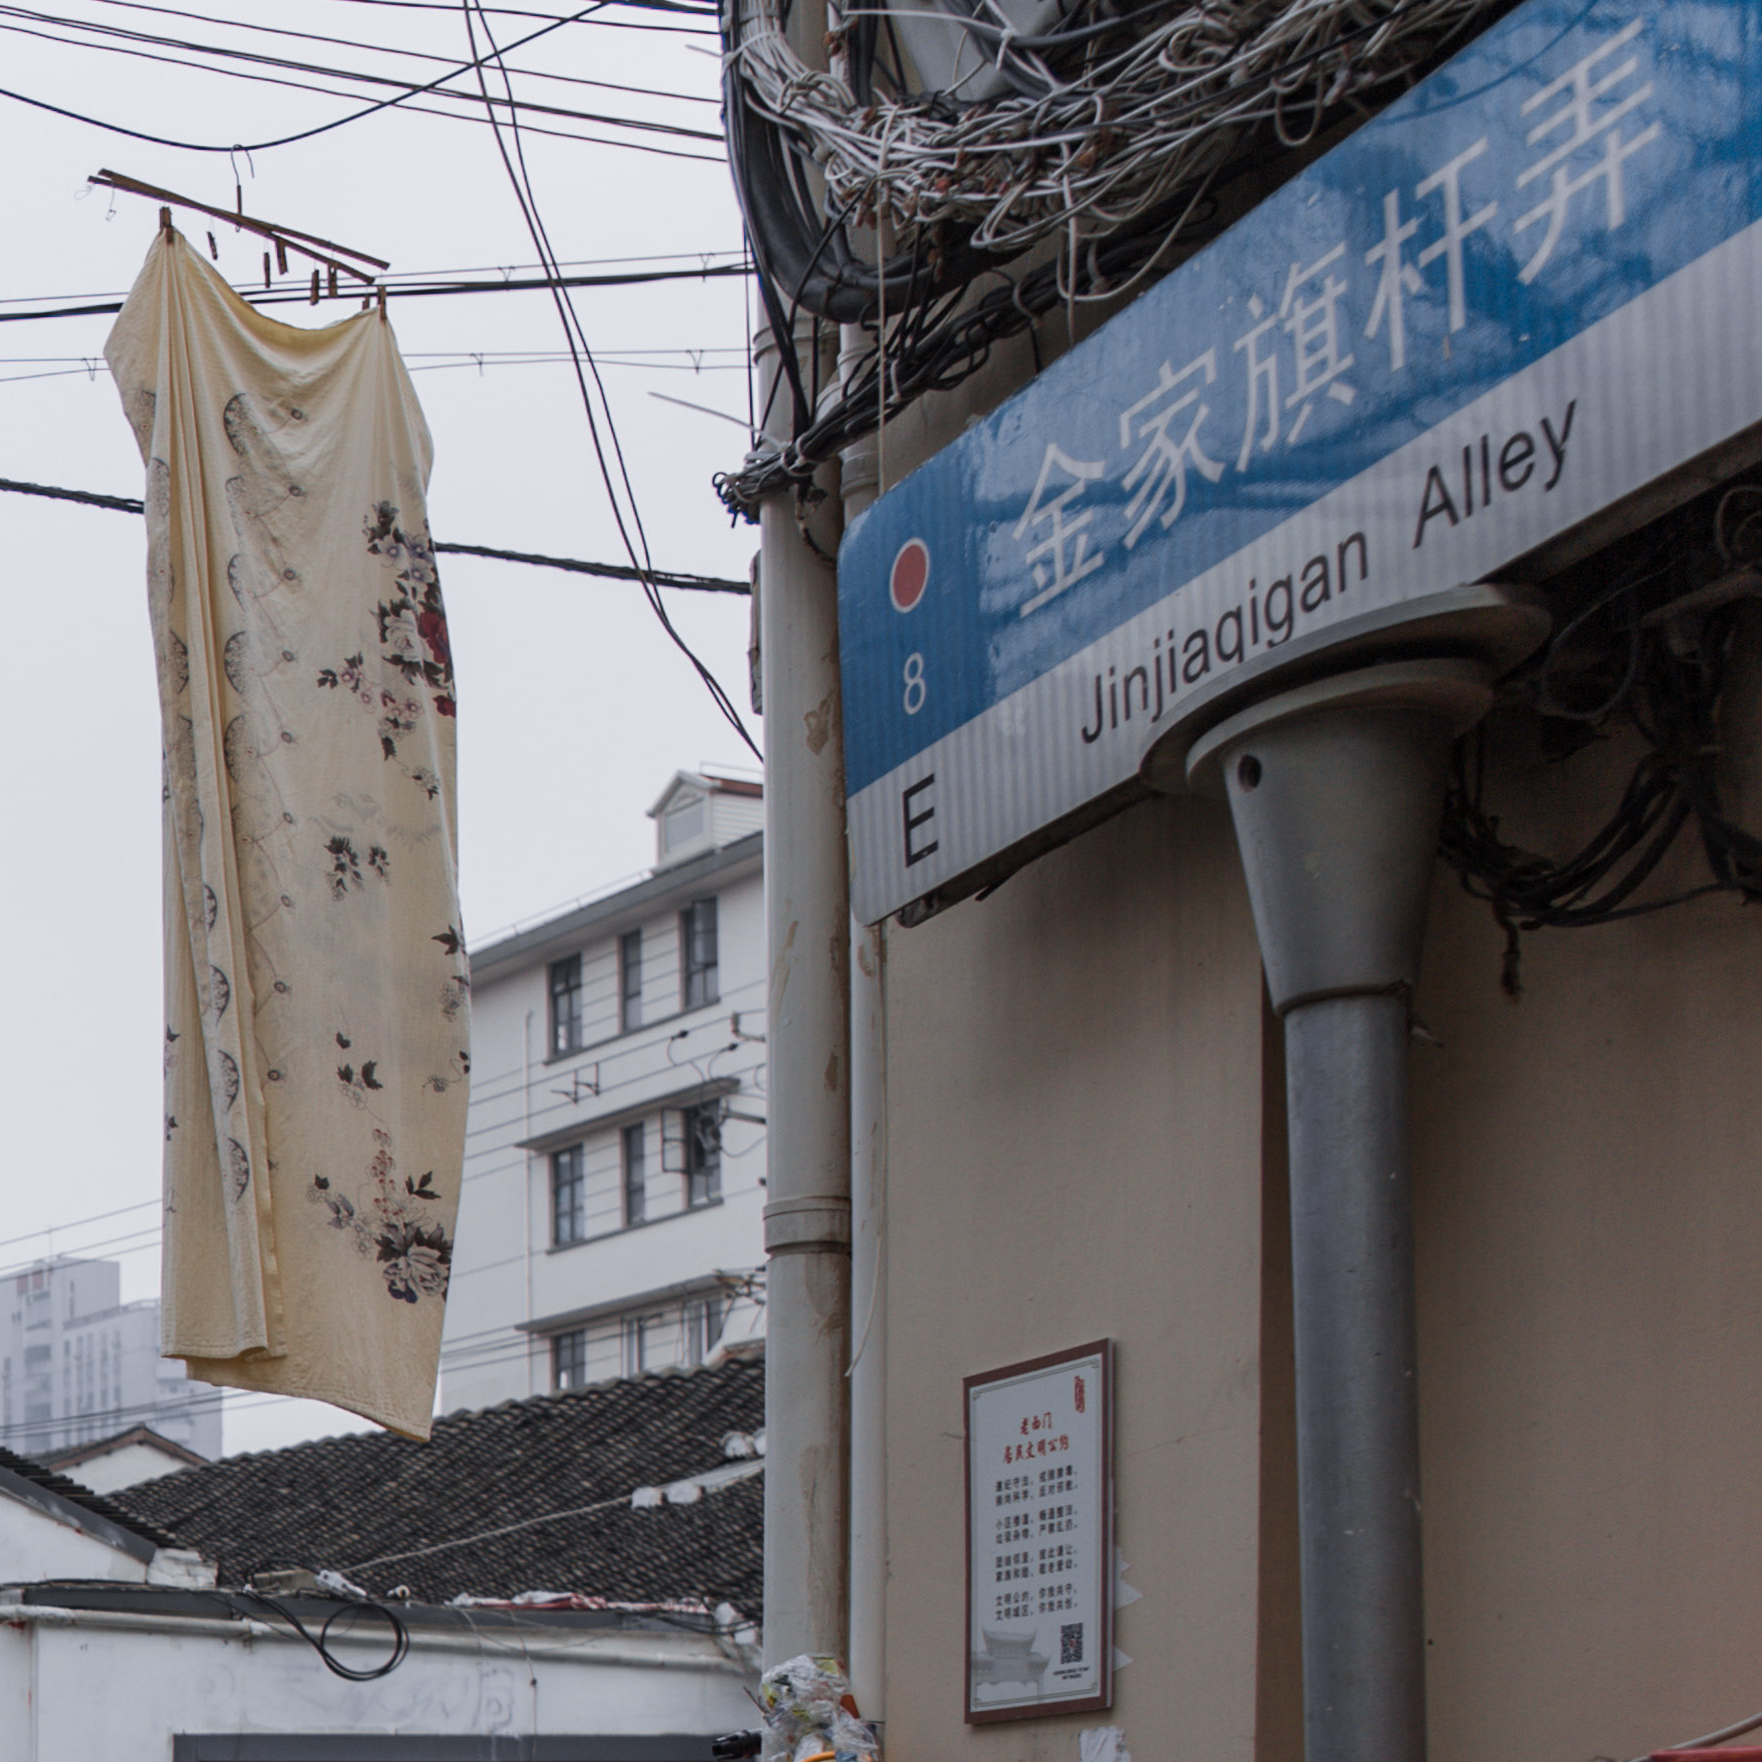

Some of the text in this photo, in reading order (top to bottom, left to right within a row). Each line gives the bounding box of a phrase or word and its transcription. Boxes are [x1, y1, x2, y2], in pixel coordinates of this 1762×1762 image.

[1012, 19, 1662, 618] 金家旗杆弄
[1080, 399, 1578, 745] Jinjiaqigan Alley
[902, 655, 927, 717] 8
[902, 774, 940, 869] E
[1003, 1434, 1069, 1464] 居民文明公约
[1020, 1411, 1052, 1435] 老西门
